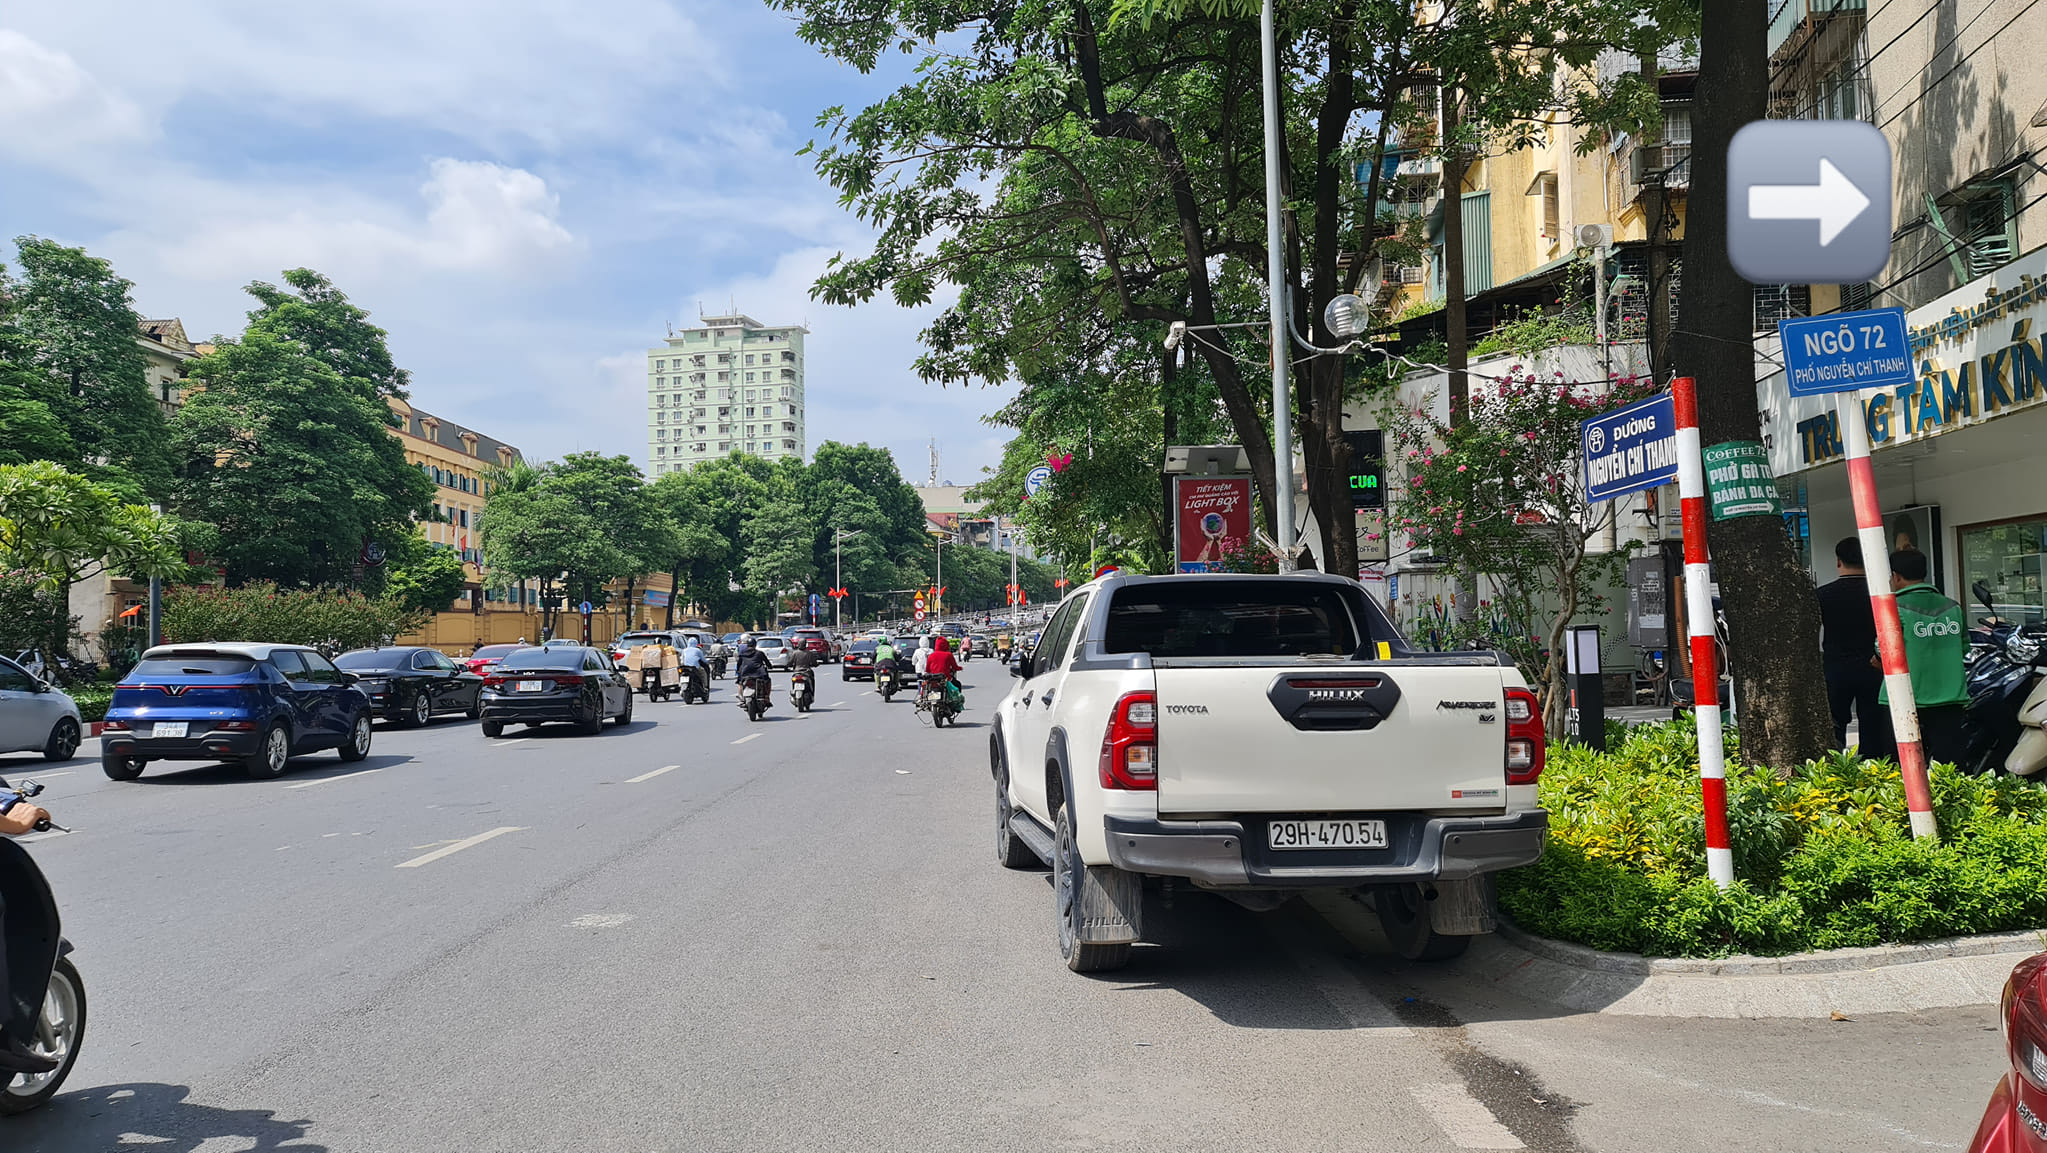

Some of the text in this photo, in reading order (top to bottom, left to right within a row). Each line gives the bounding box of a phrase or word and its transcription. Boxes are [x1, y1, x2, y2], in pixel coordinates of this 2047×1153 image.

[1804, 323, 1887, 357] NGÕ 72
[1796, 356, 1906, 384] PHỐ NGUYỄN CHÍ THANH
[1896, 358, 1974, 434] TÂM
[1613, 415, 1656, 441] ĐƯỜNG
[1627, 438, 1645, 477] CHÍ
[1706, 446, 1755, 462] COFFEE
[1709, 461, 1739, 485] PHỞ
[1185, 496, 1241, 509] LIGHT BOX
[1713, 486, 1747, 505] BÁNH
[1913, 616, 1960, 638] Grab
[1309, 689, 1365, 701] HILUX
[1165, 704, 1209, 713] TOYOTA
[1568, 707, 1580, 722] LTS
[1570, 722, 1579, 736] 10
[1271, 822, 1383, 846] 29H-470.54
